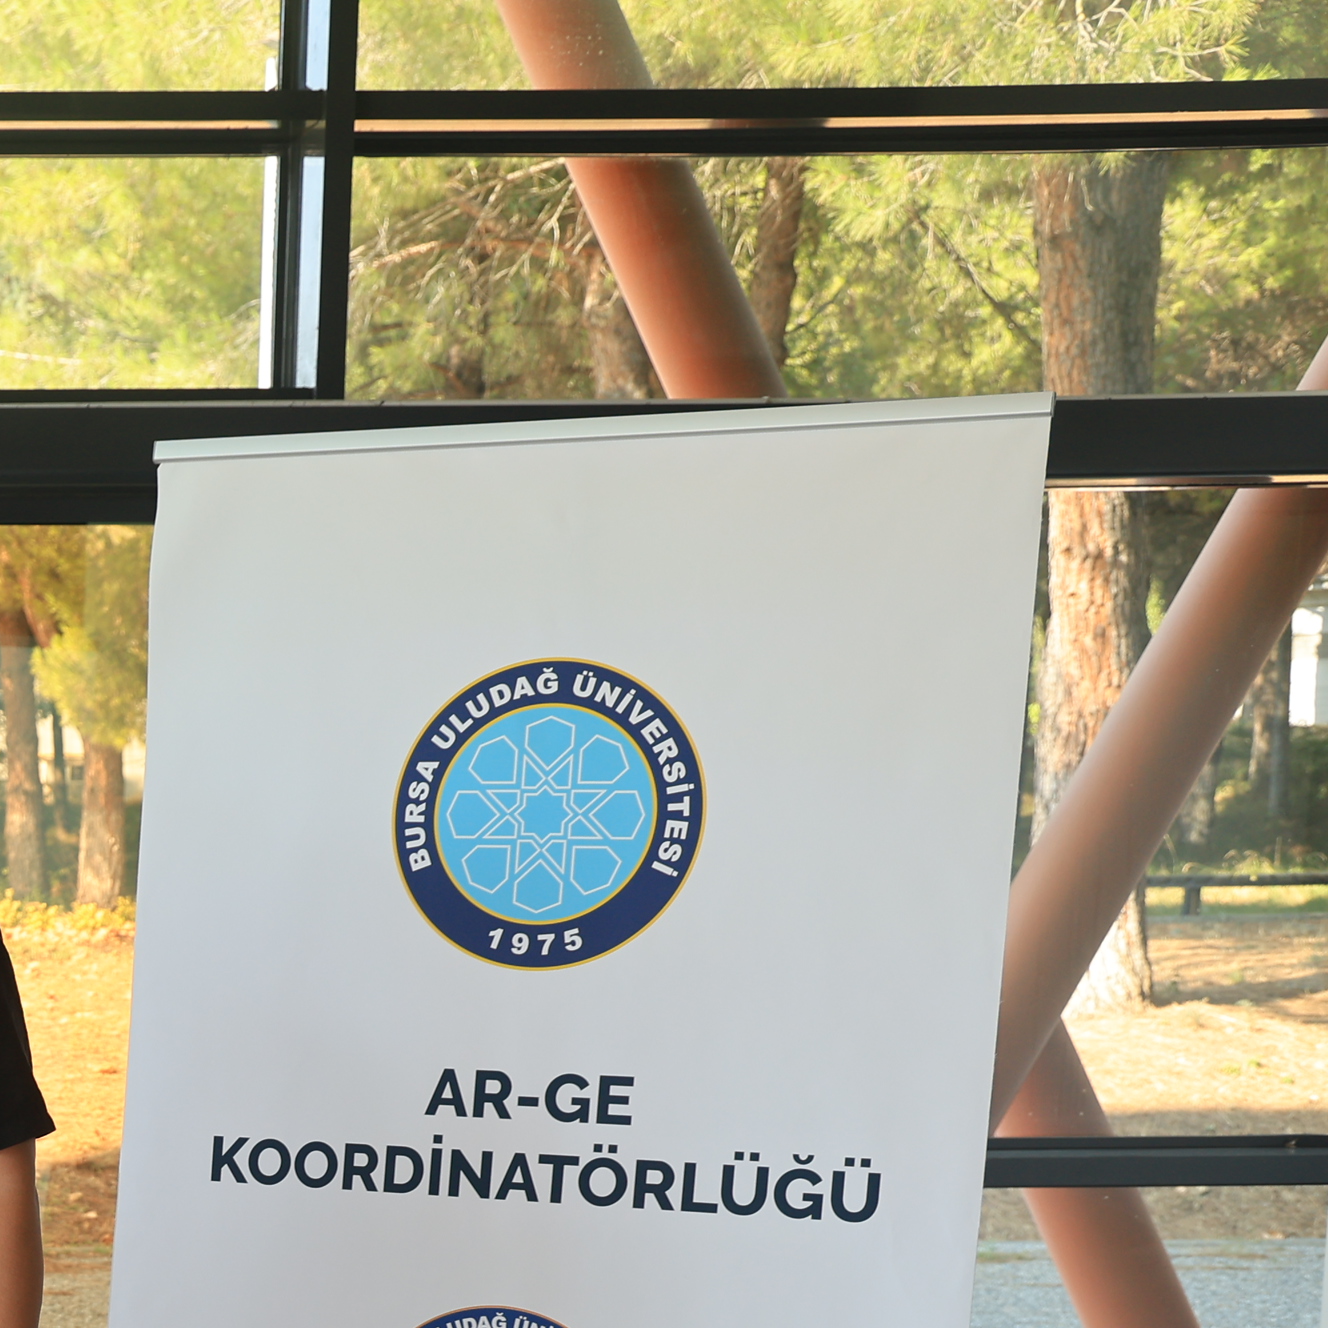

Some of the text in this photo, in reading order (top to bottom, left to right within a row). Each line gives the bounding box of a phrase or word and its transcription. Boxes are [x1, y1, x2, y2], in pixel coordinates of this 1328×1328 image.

[405, 667, 695, 877] BURSA ULUDAĞ ÜNİVERSİTESİ
[488, 927, 583, 955] 1975
[425, 1068, 635, 1126] AR-GE
[210, 1134, 882, 1223] KOORDİNATÖRLÜĞÜ
